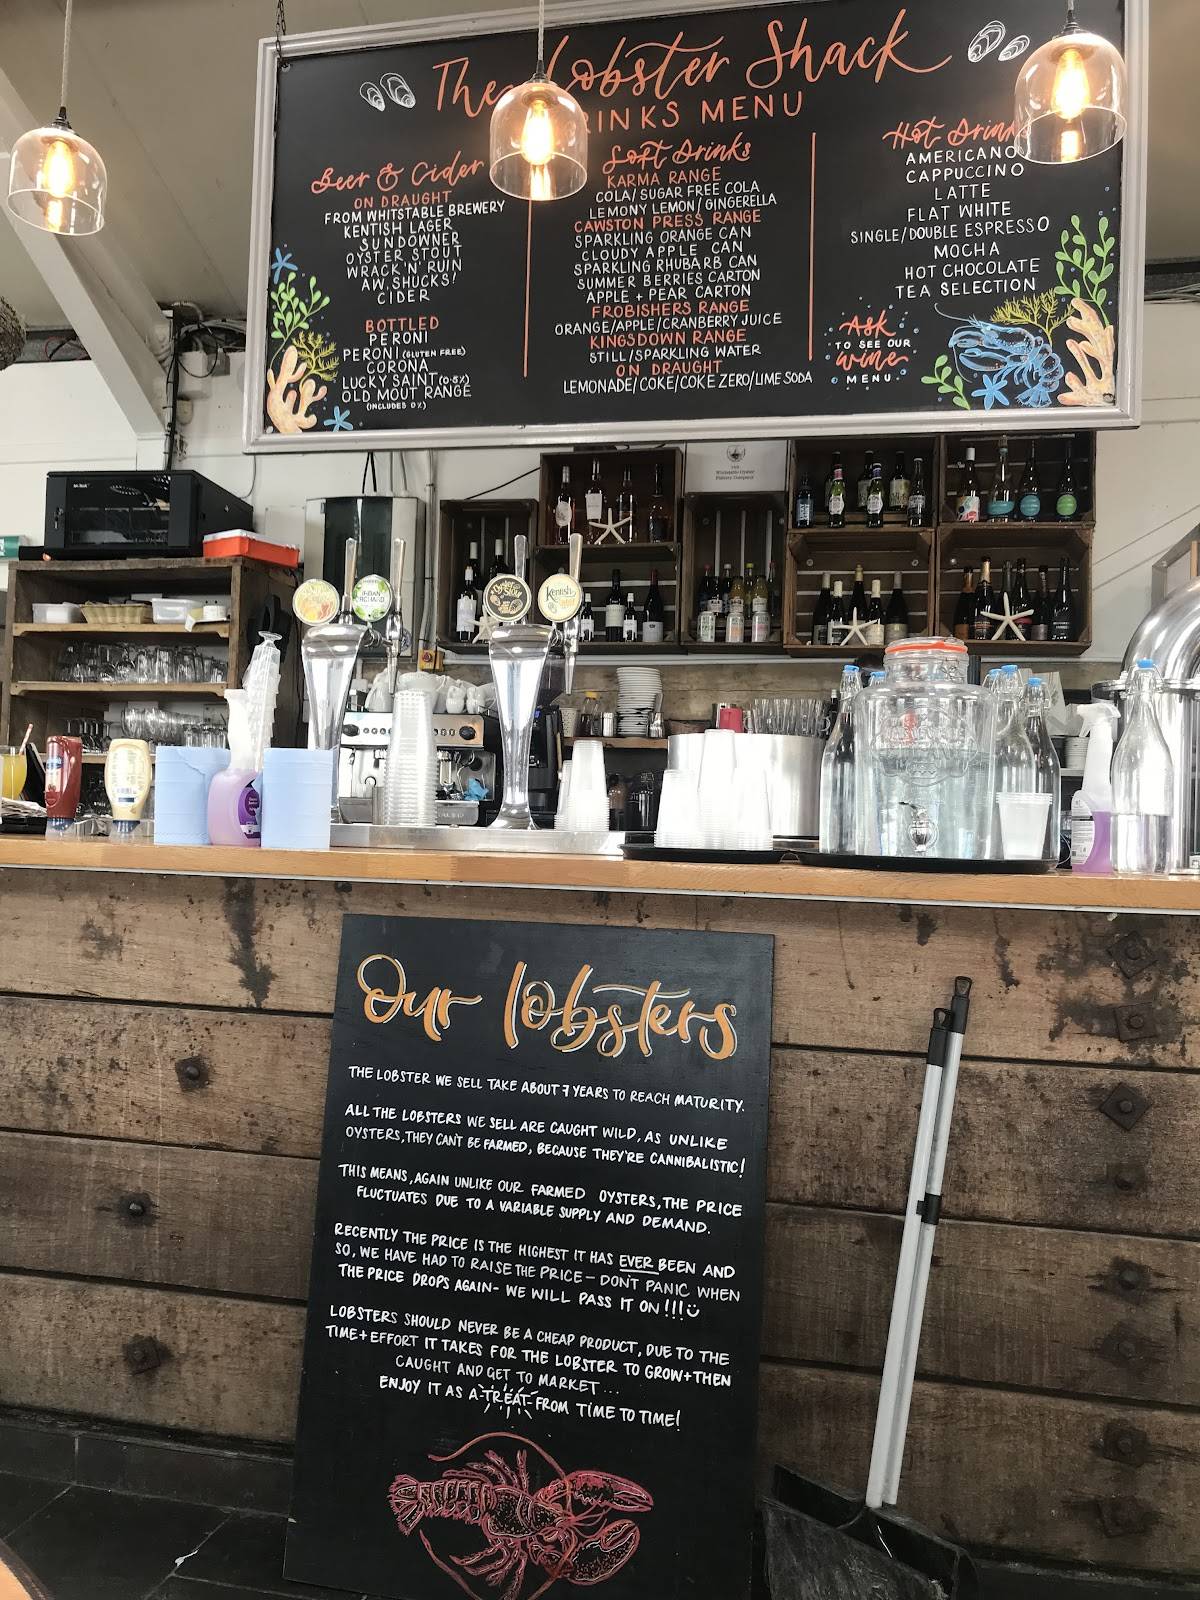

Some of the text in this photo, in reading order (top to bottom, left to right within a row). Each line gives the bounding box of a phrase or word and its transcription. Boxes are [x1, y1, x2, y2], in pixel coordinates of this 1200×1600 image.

[433, 57, 514, 118] The
[746, 9, 952, 88] Shack
[701, 91, 803, 124] MENU
[882, 116, 944, 150] Hot
[603, 132, 751, 174] Soft Drinks
[906, 145, 1016, 165] AMERICANO
[312, 151, 485, 194] Beer & Cider
[607, 167, 721, 189] KARMA RANGE
[907, 163, 1024, 183] CAPPUCCINO
[354, 191, 452, 209] ON DRAUGHT
[935, 183, 991, 200] LATTE
[325, 200, 505, 224] FROM WHITSTABLE BREWERY
[575, 210, 761, 233] CAWSTON PRESS RANGE
[590, 204, 647, 219] LEMONY
[907, 201, 1011, 222] FLAT WHITE
[344, 218, 452, 238] KENTISH LAGER
[965, 216, 1049, 238] ESPRESSO
[360, 232, 459, 251] SUNDOWNER
[575, 226, 751, 249] SPARKLING ORANGE CAN
[347, 245, 462, 264] OYSTER STOUT
[582, 241, 743, 261] CLOUDY APPLE CAN
[934, 242, 999, 259] MOCHA
[347, 264, 400, 279] WRACK
[428, 260, 462, 272] RUIN
[574, 255, 757, 275] SPARKLING RHUBARB CAN
[905, 258, 1040, 280] HOT CHOCOLATE
[577, 269, 760, 290] SUMMER BERRIES CARTON
[896, 277, 1035, 299] TEA SELECTION
[377, 289, 429, 304] CIDER
[586, 291, 629, 303] APPLE
[650, 288, 687, 301] PEAR
[695, 284, 751, 298] CARTON
[592, 300, 749, 318] FROBISHERS RANGE
[741, 313, 782, 325] JUICE
[366, 316, 439, 333] BOTTLED
[370, 332, 428, 346] PERONI
[590, 328, 747, 349] KINGSDOWN RANGE
[887, 339, 911, 347] OUR
[343, 348, 399, 361] PERONI
[716, 344, 761, 356] WATER
[367, 359, 428, 374] CORONA
[616, 360, 723, 377] ON DRAUGHT
[836, 350, 909, 371] wine
[343, 376, 387, 390] LUCKY
[393, 373, 438, 387] SAINT
[786, 371, 812, 384] SODA
[847, 374, 891, 384] MENU
[342, 385, 471, 403] OLD MOUT RANGE
[356, 954, 738, 1060] Our lobsters
[349, 1066, 745, 1112] THE LOBSTER WE SELL TAKE ABOUT 7 YEARS TO REACH MATURITY.
[345, 1104, 728, 1150] ALL THE LOBSTERS WE SELL ARE CAUGHT WILD, AS UNLIKE
[357, 1186, 710, 1234] FLUCTUATES DUE TO A VARIABLE SUPPLY AND DEMAND.
[335, 1223, 735, 1279] RECENTLY THE PRICE IS THE HIGHEST IT HAS EVER BEEN AND
[330, 1305, 730, 1365] LOBSTERS SHOULD NEVER BE A CHEAP PRODUCT, DUE TO THE
